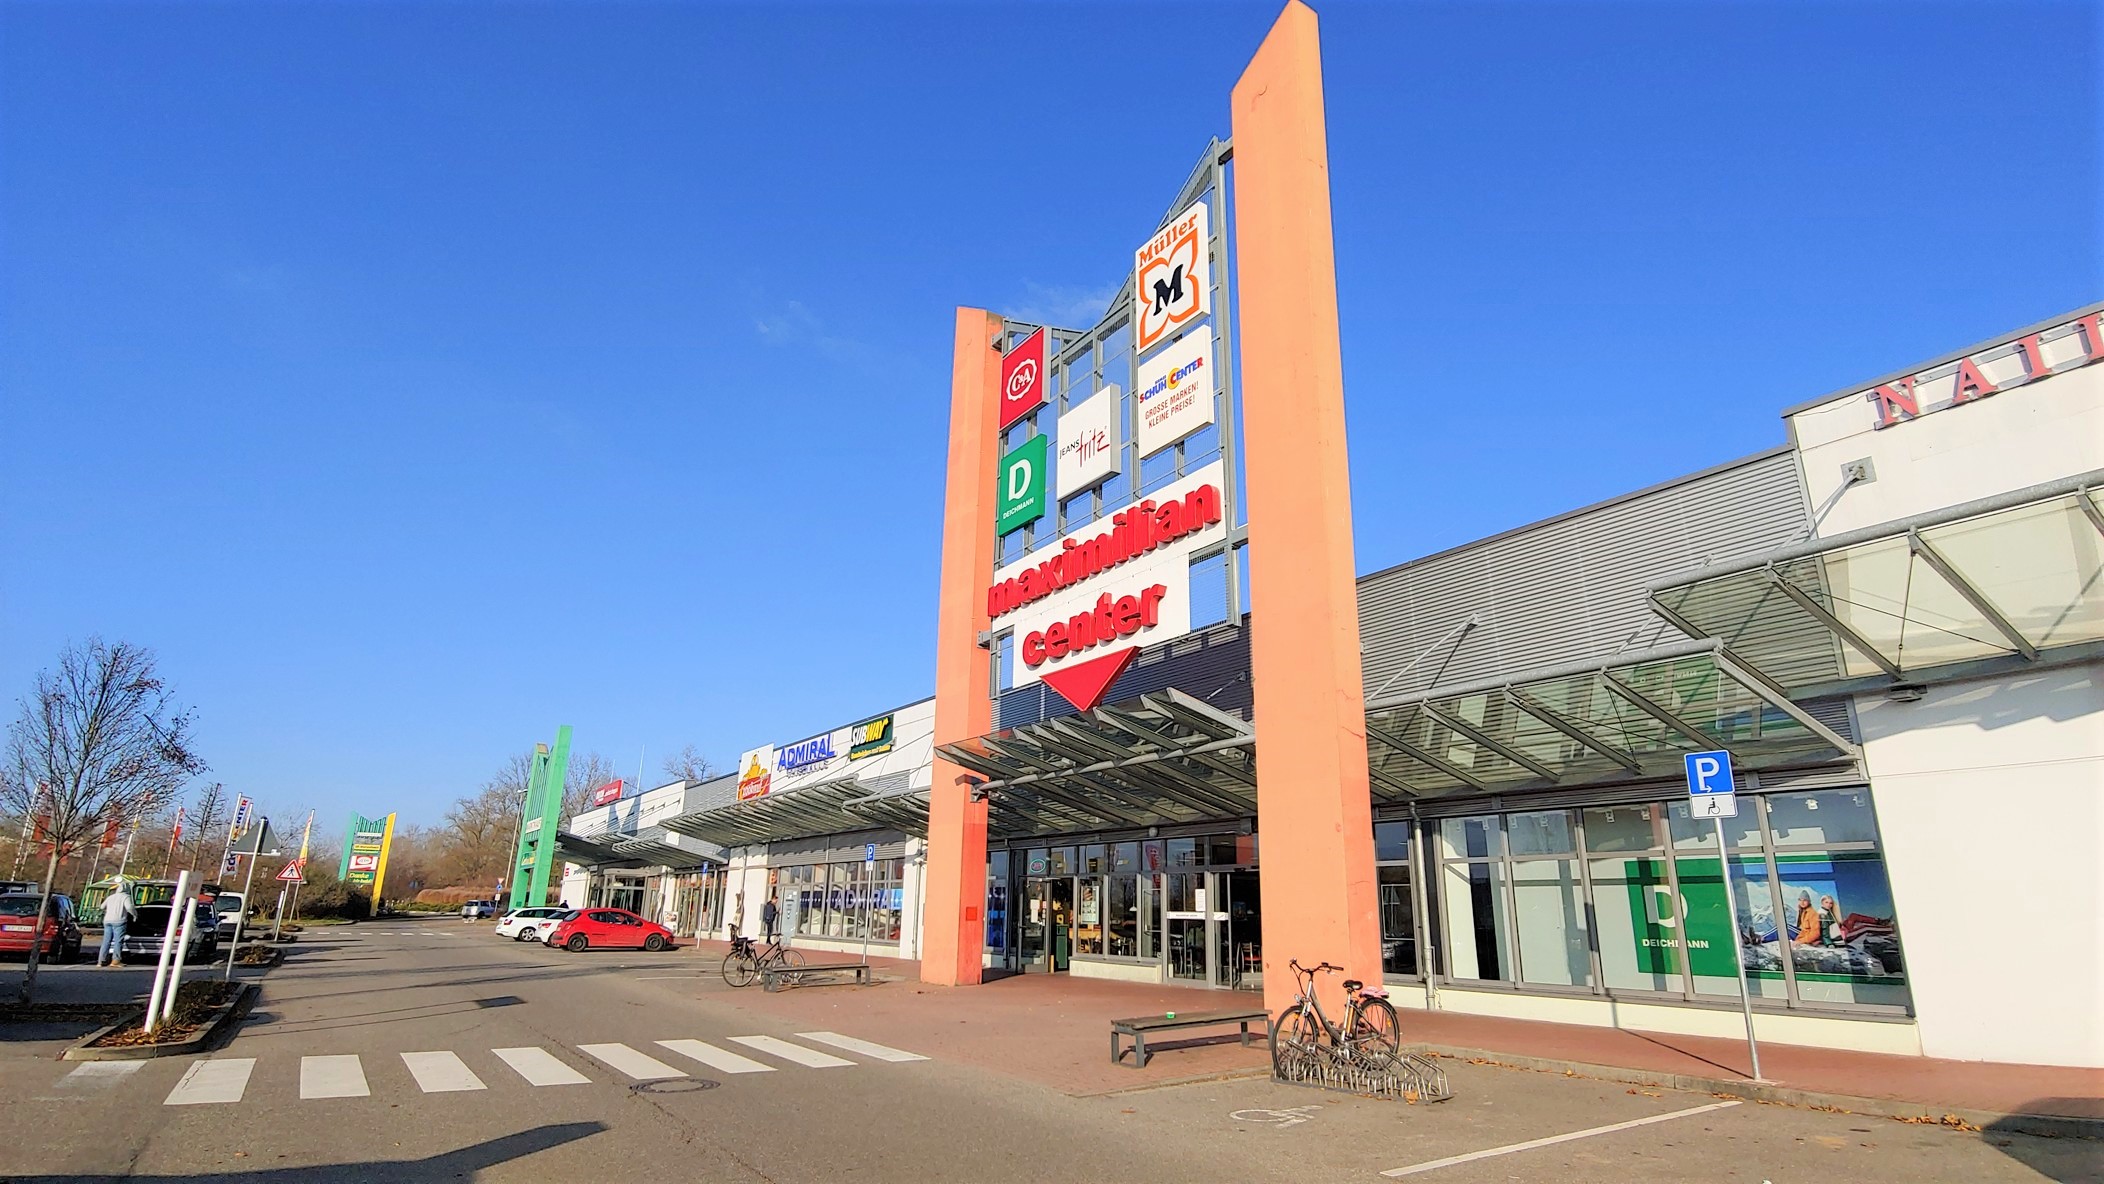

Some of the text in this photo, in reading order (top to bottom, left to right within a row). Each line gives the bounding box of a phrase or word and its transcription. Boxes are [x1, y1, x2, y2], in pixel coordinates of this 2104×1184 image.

[1139, 213, 1198, 268] Müller
[1153, 264, 1184, 317] M
[1011, 367, 1032, 392] C&A
[1139, 356, 1204, 404] SCHUH CENTER
[1145, 380, 1199, 420] GROSSE MARKEN!
[1148, 394, 1196, 429] KLEINE PREISE!
[1059, 439, 1080, 460] JEANS
[1008, 458, 1032, 502] D
[1003, 496, 1035, 520] DEICHMANN
[988, 484, 1221, 618] maximilian
[1022, 584, 1168, 667] center
[851, 716, 889, 747] SUBWAY
[777, 733, 836, 771] ADMIRAL
[1695, 757, 1720, 791] P
[867, 846, 874, 860] P
[1643, 884, 1688, 928] D
[1642, 938, 1710, 949] DEICHANN
